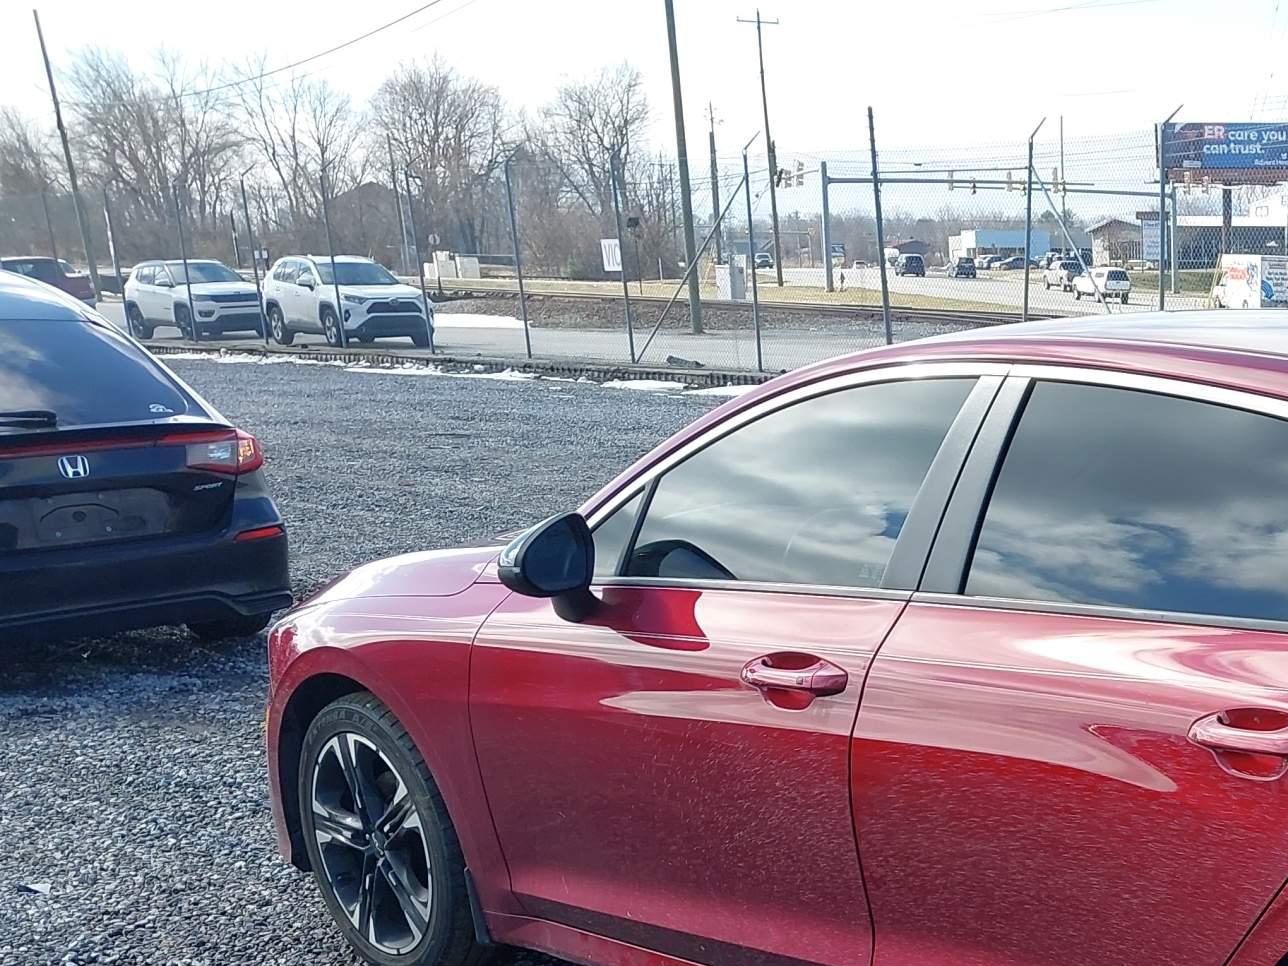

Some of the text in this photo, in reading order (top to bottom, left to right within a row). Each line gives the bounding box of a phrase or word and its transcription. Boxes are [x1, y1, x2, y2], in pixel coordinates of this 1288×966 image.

[1204, 125, 1225, 139] ER
[1228, 130, 1258, 140] care
[1261, 131, 1286, 142] you
[1203, 143, 1265, 154] can trust.
